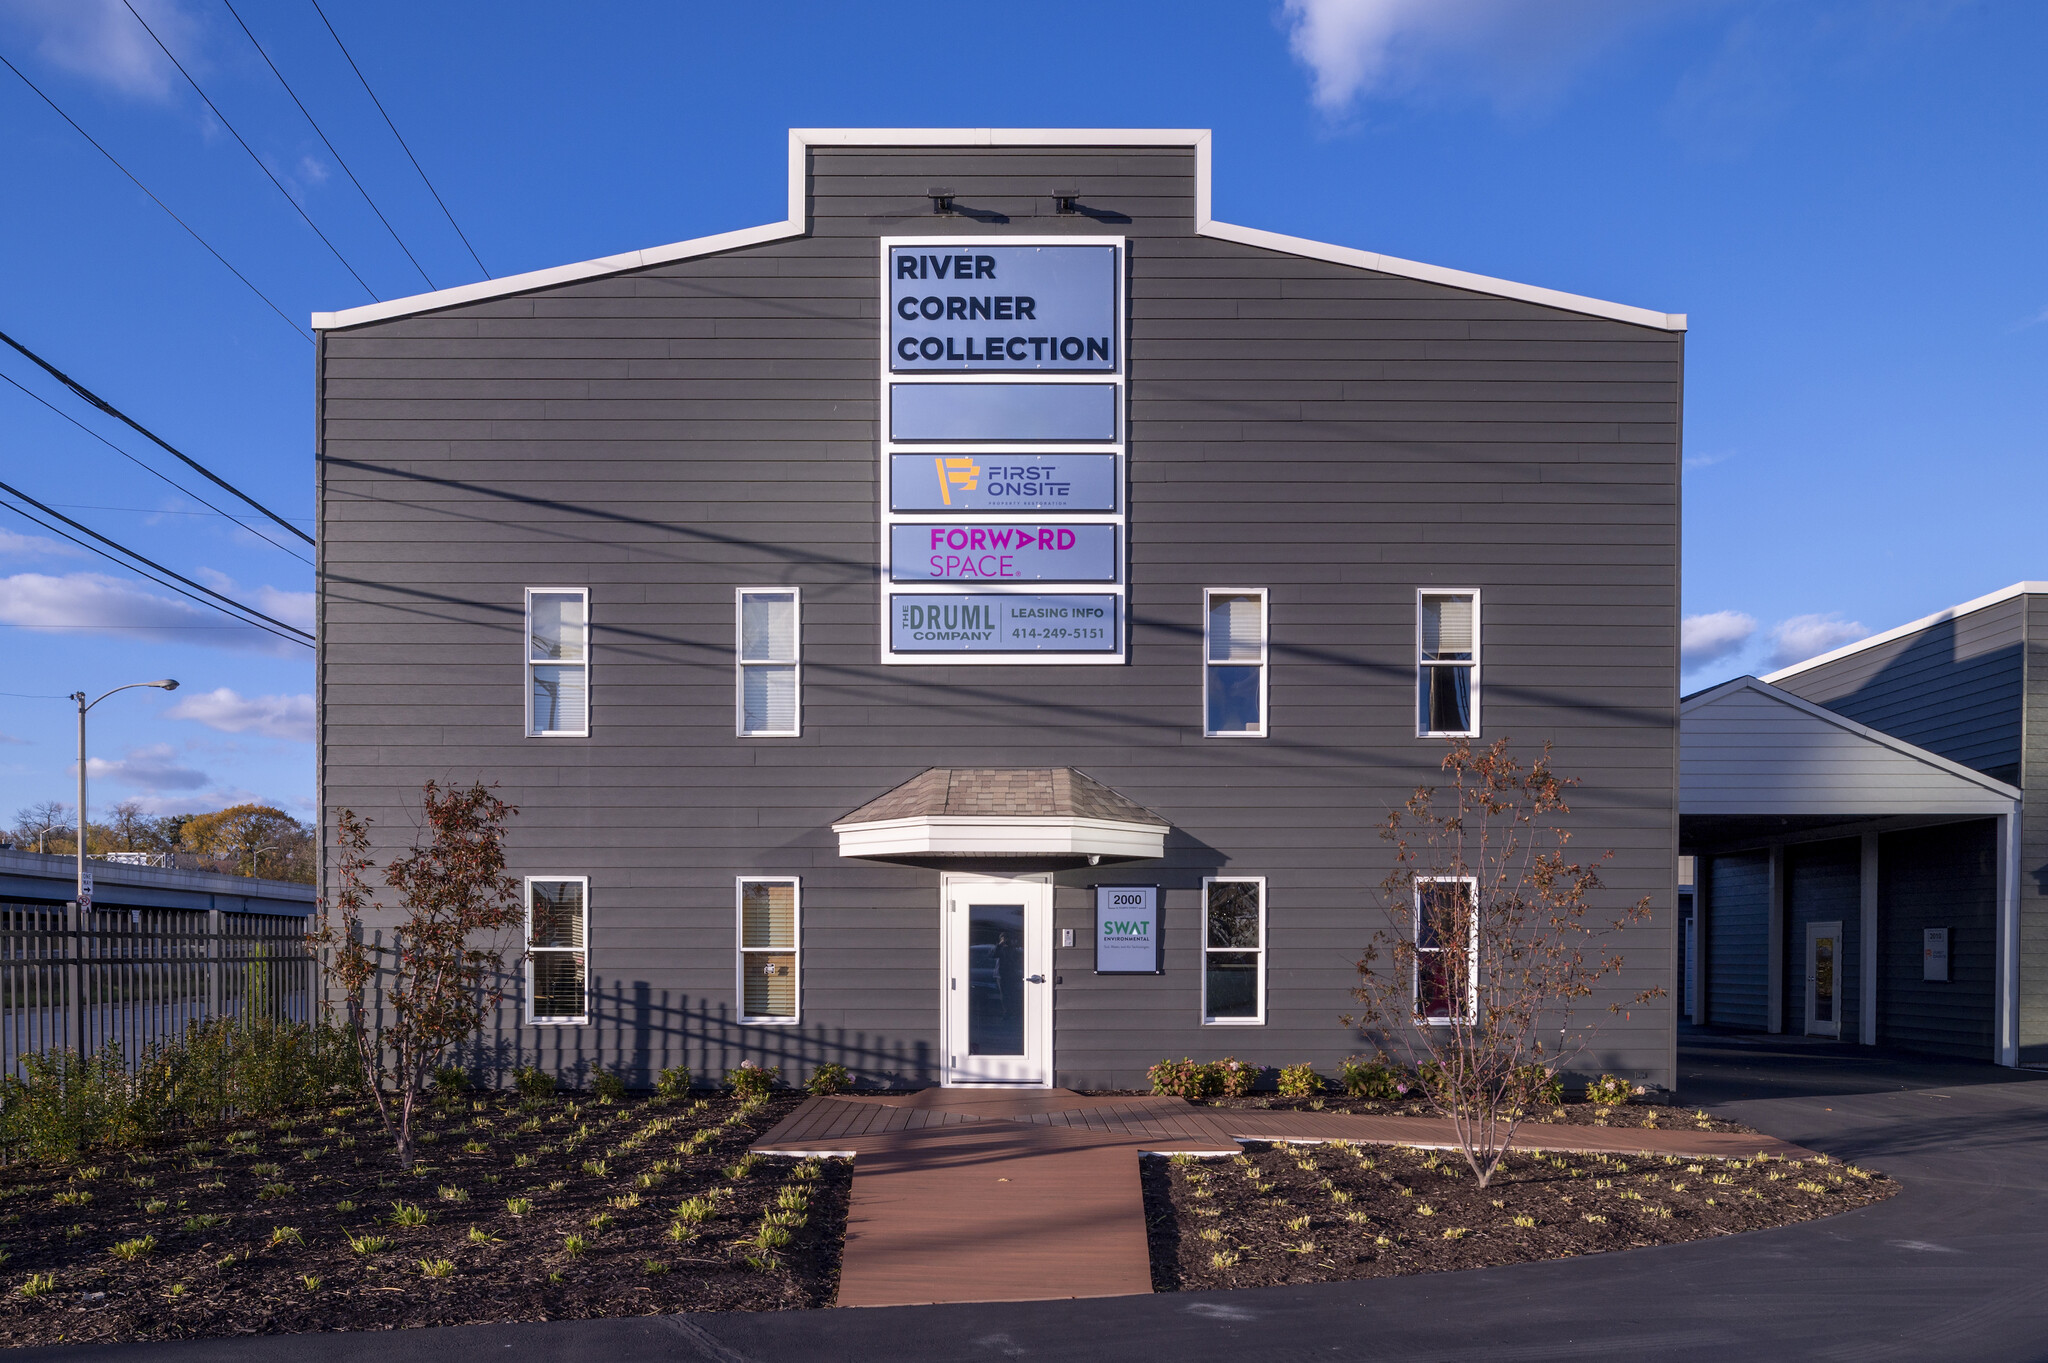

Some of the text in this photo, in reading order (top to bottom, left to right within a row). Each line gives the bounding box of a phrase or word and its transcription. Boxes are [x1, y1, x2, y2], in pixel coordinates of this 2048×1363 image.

[897, 255, 996, 279] RIVER
[897, 296, 1036, 320] CORNER
[897, 337, 1109, 361] COLLECTION
[988, 466, 1056, 480] FIRST
[987, 482, 1071, 496] ONSITE
[930, 528, 1076, 551] FORWARD
[910, 605, 995, 629] DRUML
[1011, 608, 1104, 618] LEASING INFO
[912, 631, 992, 641] COMPANY
[1012, 628, 1104, 639] 414-249-5151
[1113, 894, 1142, 905] 2000
[1104, 921, 1150, 935] SWAT
